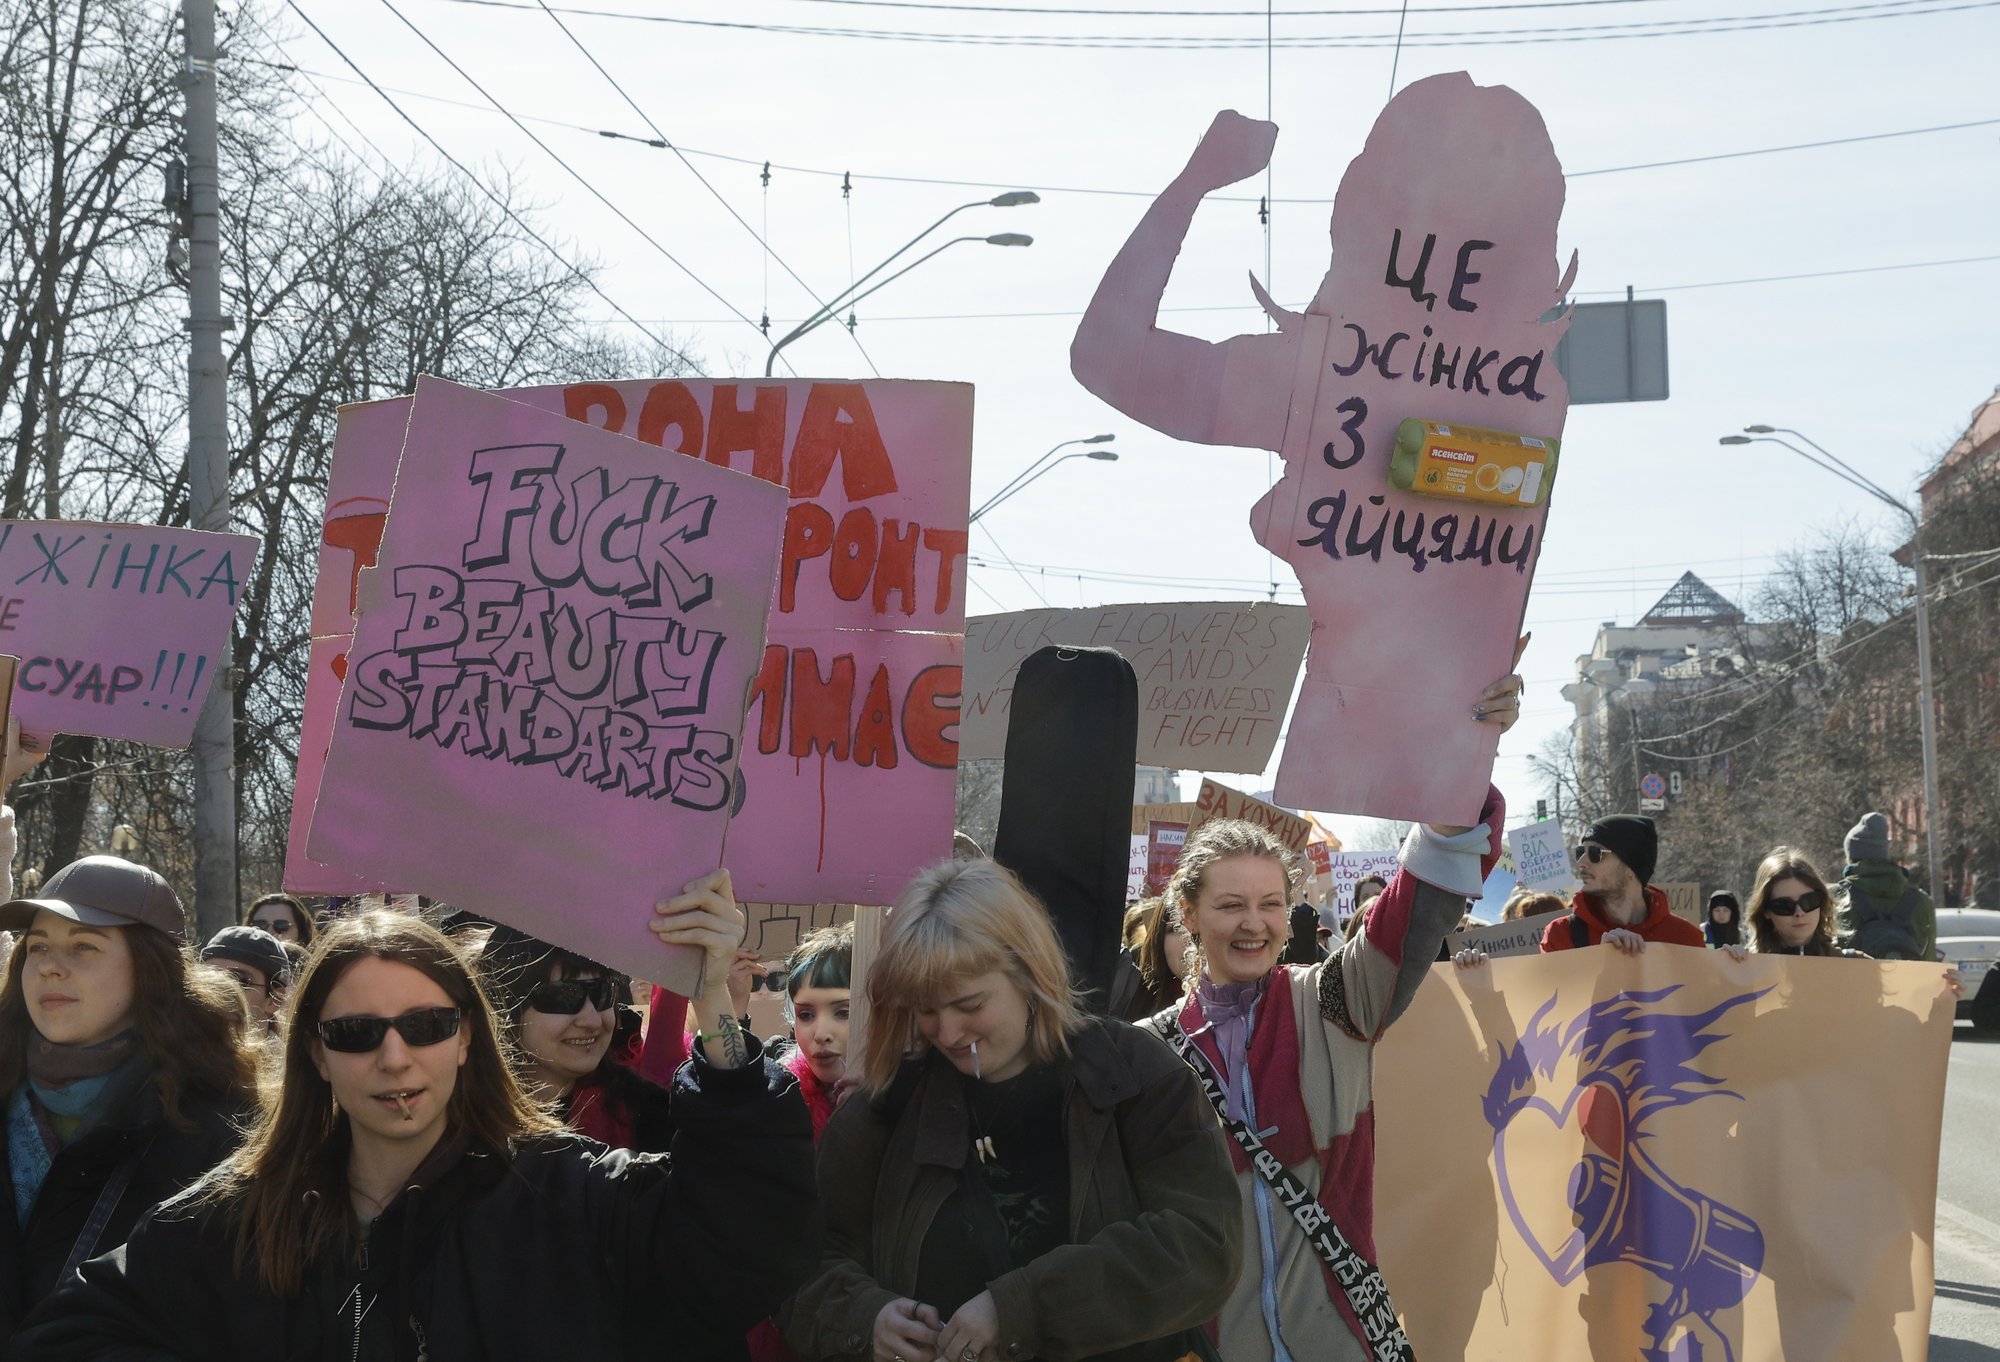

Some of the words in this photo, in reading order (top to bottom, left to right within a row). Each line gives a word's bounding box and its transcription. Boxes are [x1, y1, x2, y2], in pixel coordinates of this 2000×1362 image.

[1385, 228, 1496, 312] ЦЕ
[463, 443, 718, 612] FUCK
[779, 502, 966, 617] РОНТ
[394, 564, 728, 719] BEAUTY
[965, 615, 1070, 653] FUCK
[1090, 610, 1286, 649] FLOWERS
[18, 650, 206, 713] СУАР!!!
[1146, 687, 1276, 712] BUSINESS
[349, 649, 735, 812] STANDARTS
[1153, 714, 1274, 749] FIGHT
[1196, 783, 1229, 817] ЗА
[1238, 798, 1309, 849] КОЖНУ
